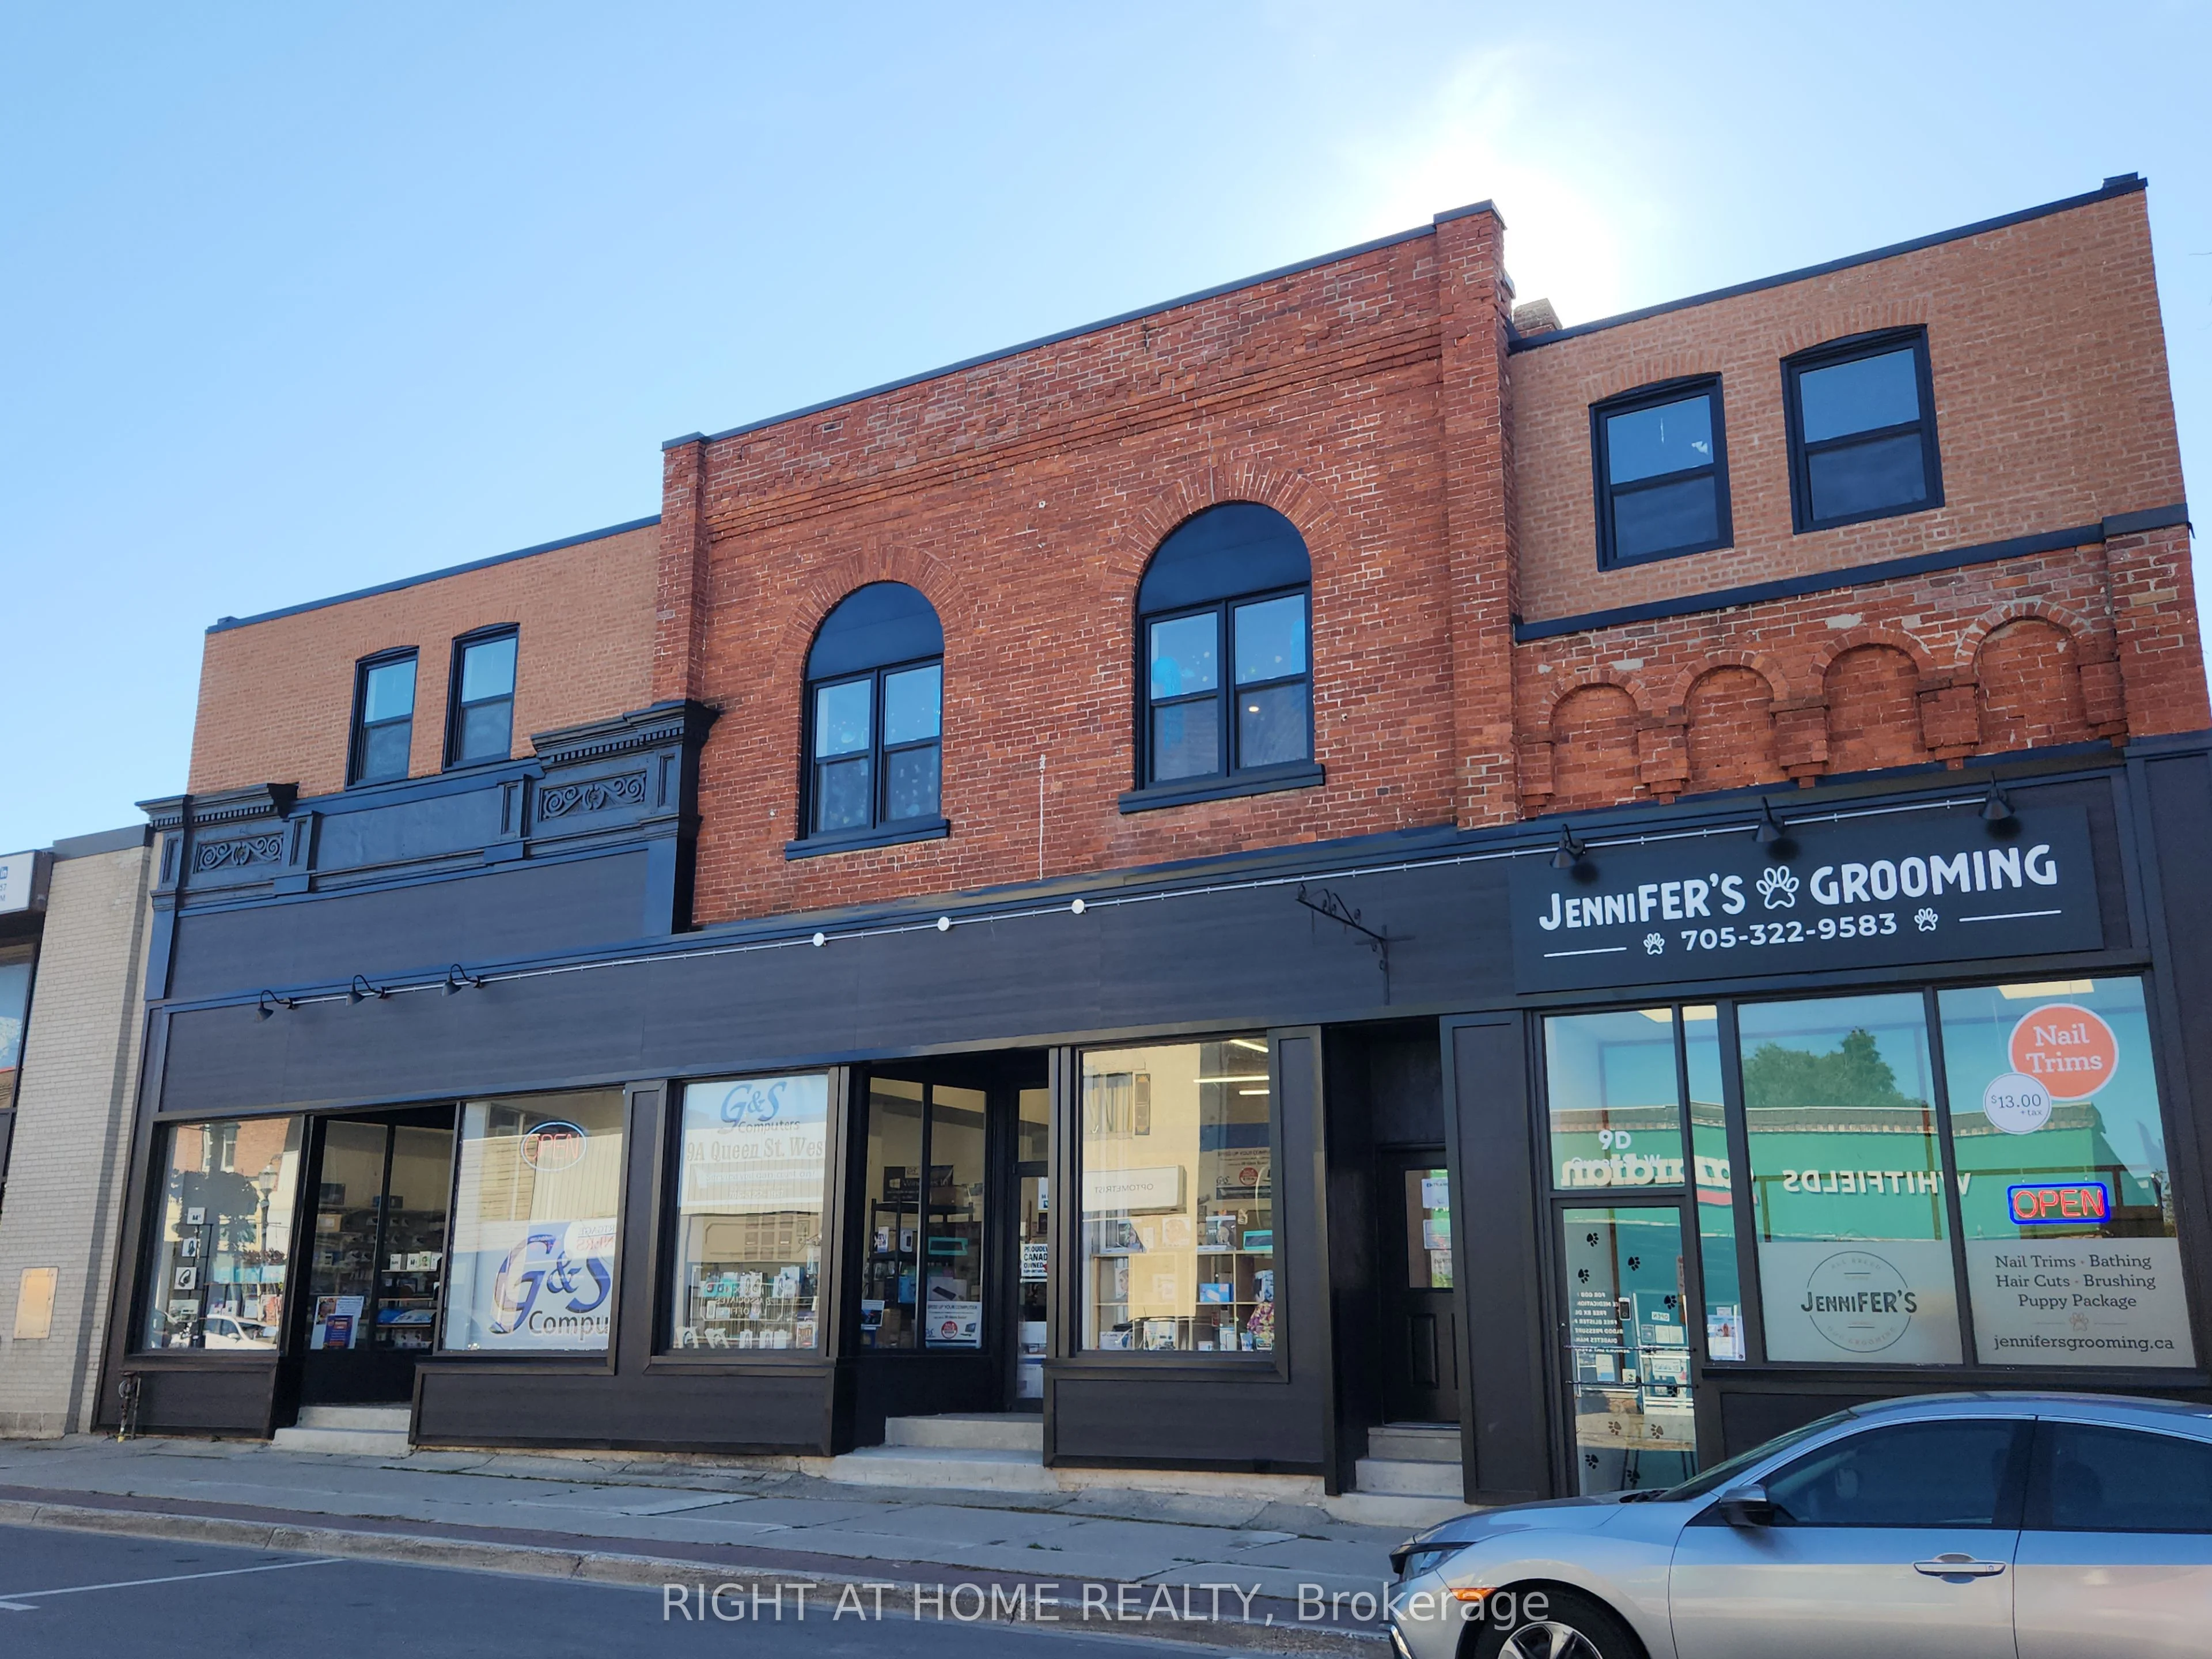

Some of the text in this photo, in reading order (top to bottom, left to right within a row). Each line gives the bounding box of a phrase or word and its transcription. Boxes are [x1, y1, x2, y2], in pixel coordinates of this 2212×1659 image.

[1810, 844, 2058, 906] GROOMING
[1681, 912, 1897, 952] 705-322-9583
[2033, 1023, 2090, 1047] Nail
[2025, 1052, 2103, 1073] Trims
[718, 1081, 787, 1134] G&S
[1991, 1094, 2041, 1109] $13.00
[738, 1120, 800, 1134] Computers
[524, 1133, 580, 1160] OPEN
[687, 1142, 705, 1161] 9A
[711, 1141, 759, 1161] Queen
[764, 1138, 785, 1157] St.
[1598, 1129, 1631, 1150] 9D
[1644, 1154, 1660, 1166] W
[2013, 1188, 2105, 1218] OPEN
[1995, 1254, 2152, 1270] Nail Trims Bathing
[1995, 1274, 2156, 1290] Hair Cuts Brushing
[2017, 1294, 2137, 1310] Puppy Package
[1994, 1335, 2175, 1352] jennifersgrooming.ca
